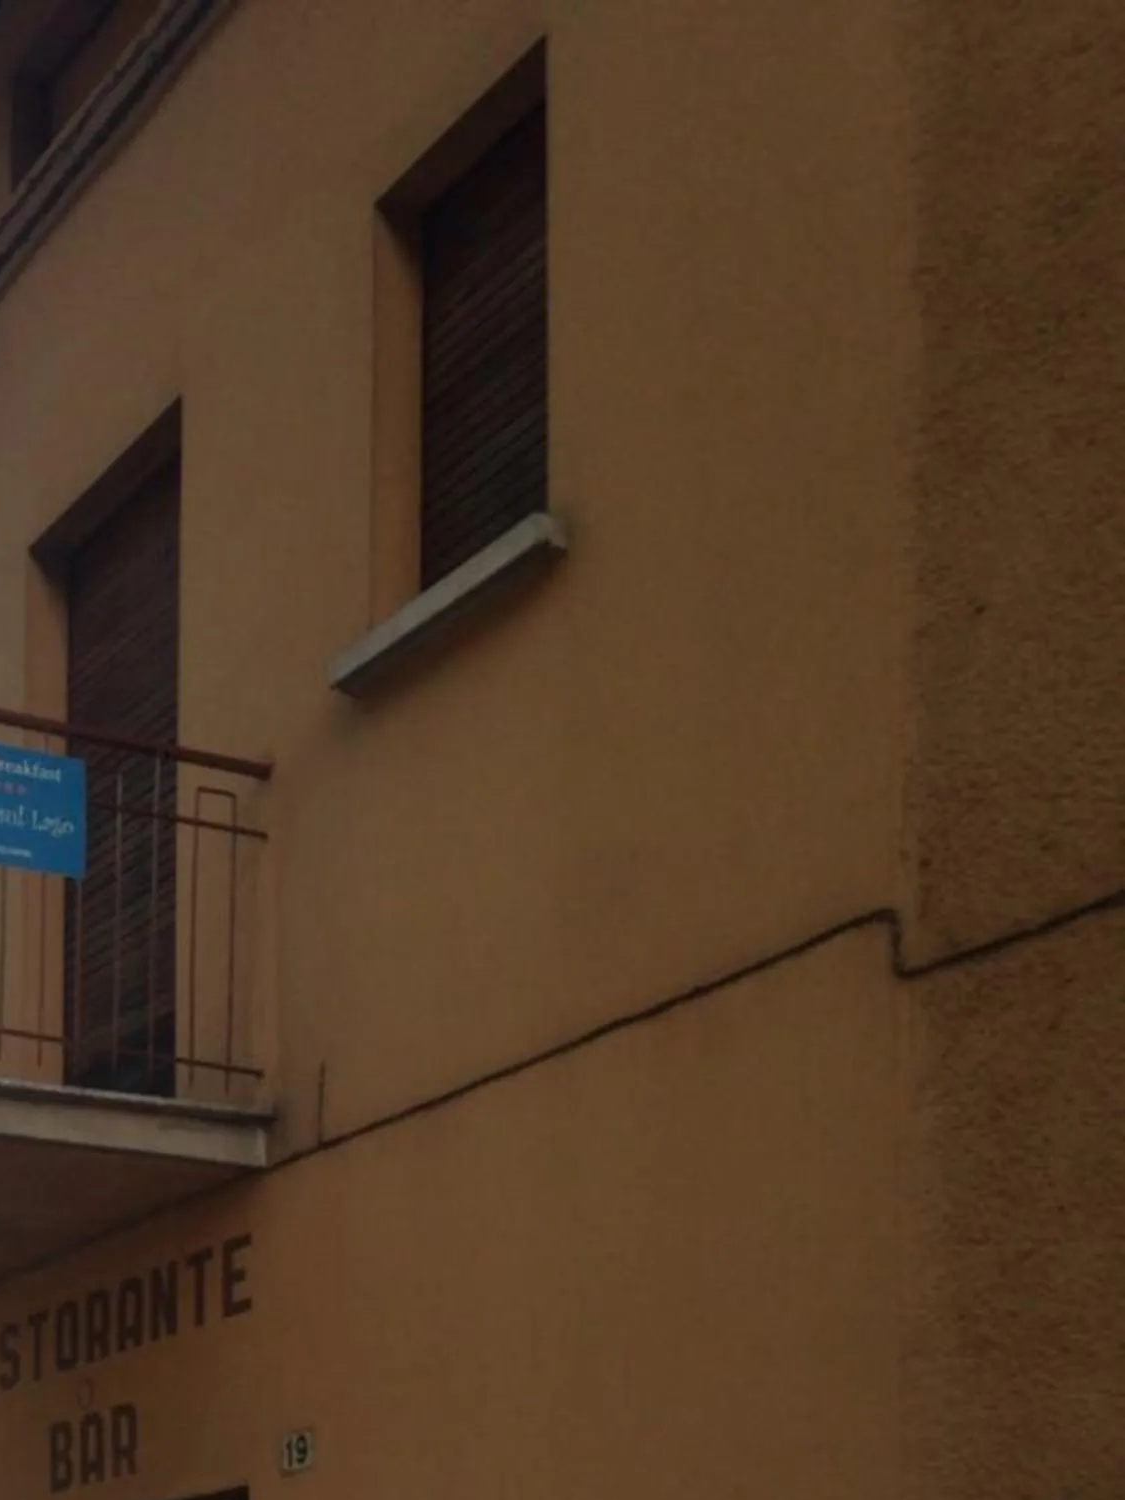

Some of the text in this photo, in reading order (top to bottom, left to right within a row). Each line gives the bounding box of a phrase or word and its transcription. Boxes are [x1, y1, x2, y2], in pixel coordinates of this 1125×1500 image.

[31, 808, 76, 839] Lago
[49, 1404, 139, 1493] BAR
[285, 1434, 309, 1467] 19
